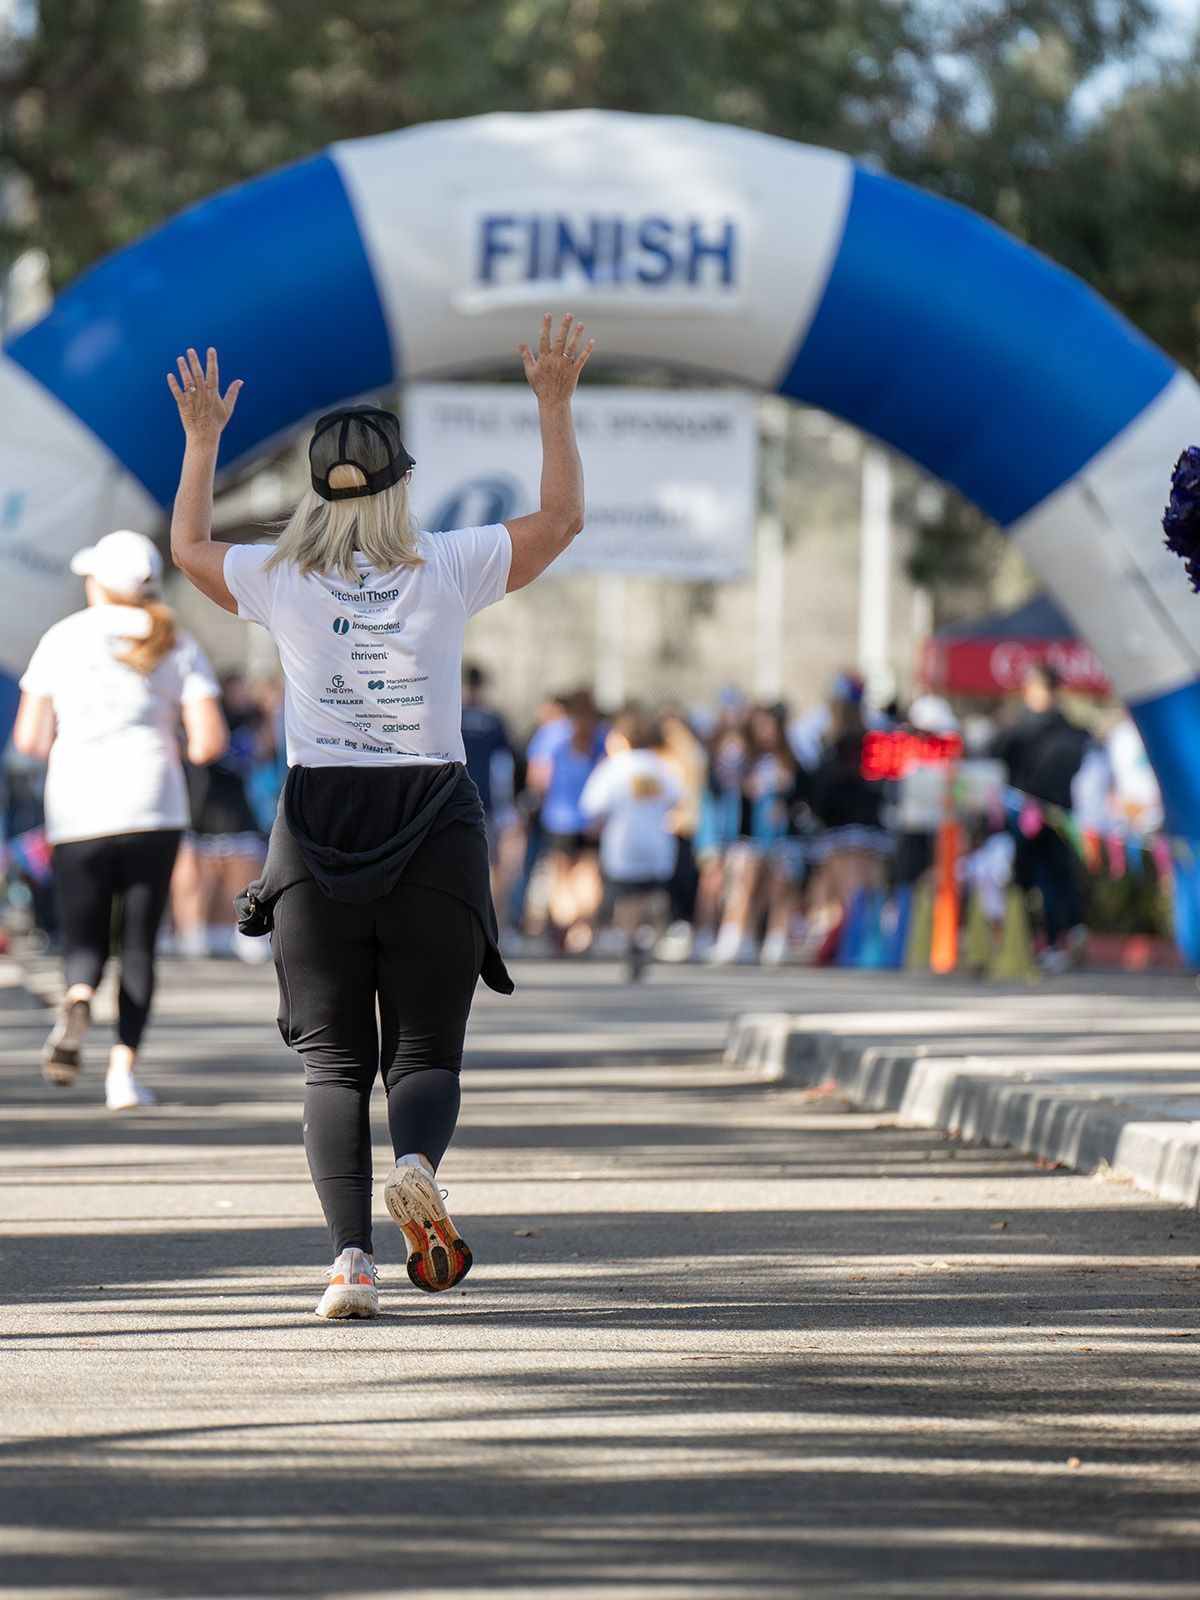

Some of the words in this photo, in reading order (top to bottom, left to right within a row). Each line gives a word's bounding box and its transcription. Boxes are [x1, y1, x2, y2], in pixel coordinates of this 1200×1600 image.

[477, 212, 738, 288] FINISH
[352, 621, 400, 632] Independent
[383, 723, 420, 731] carlsbad
